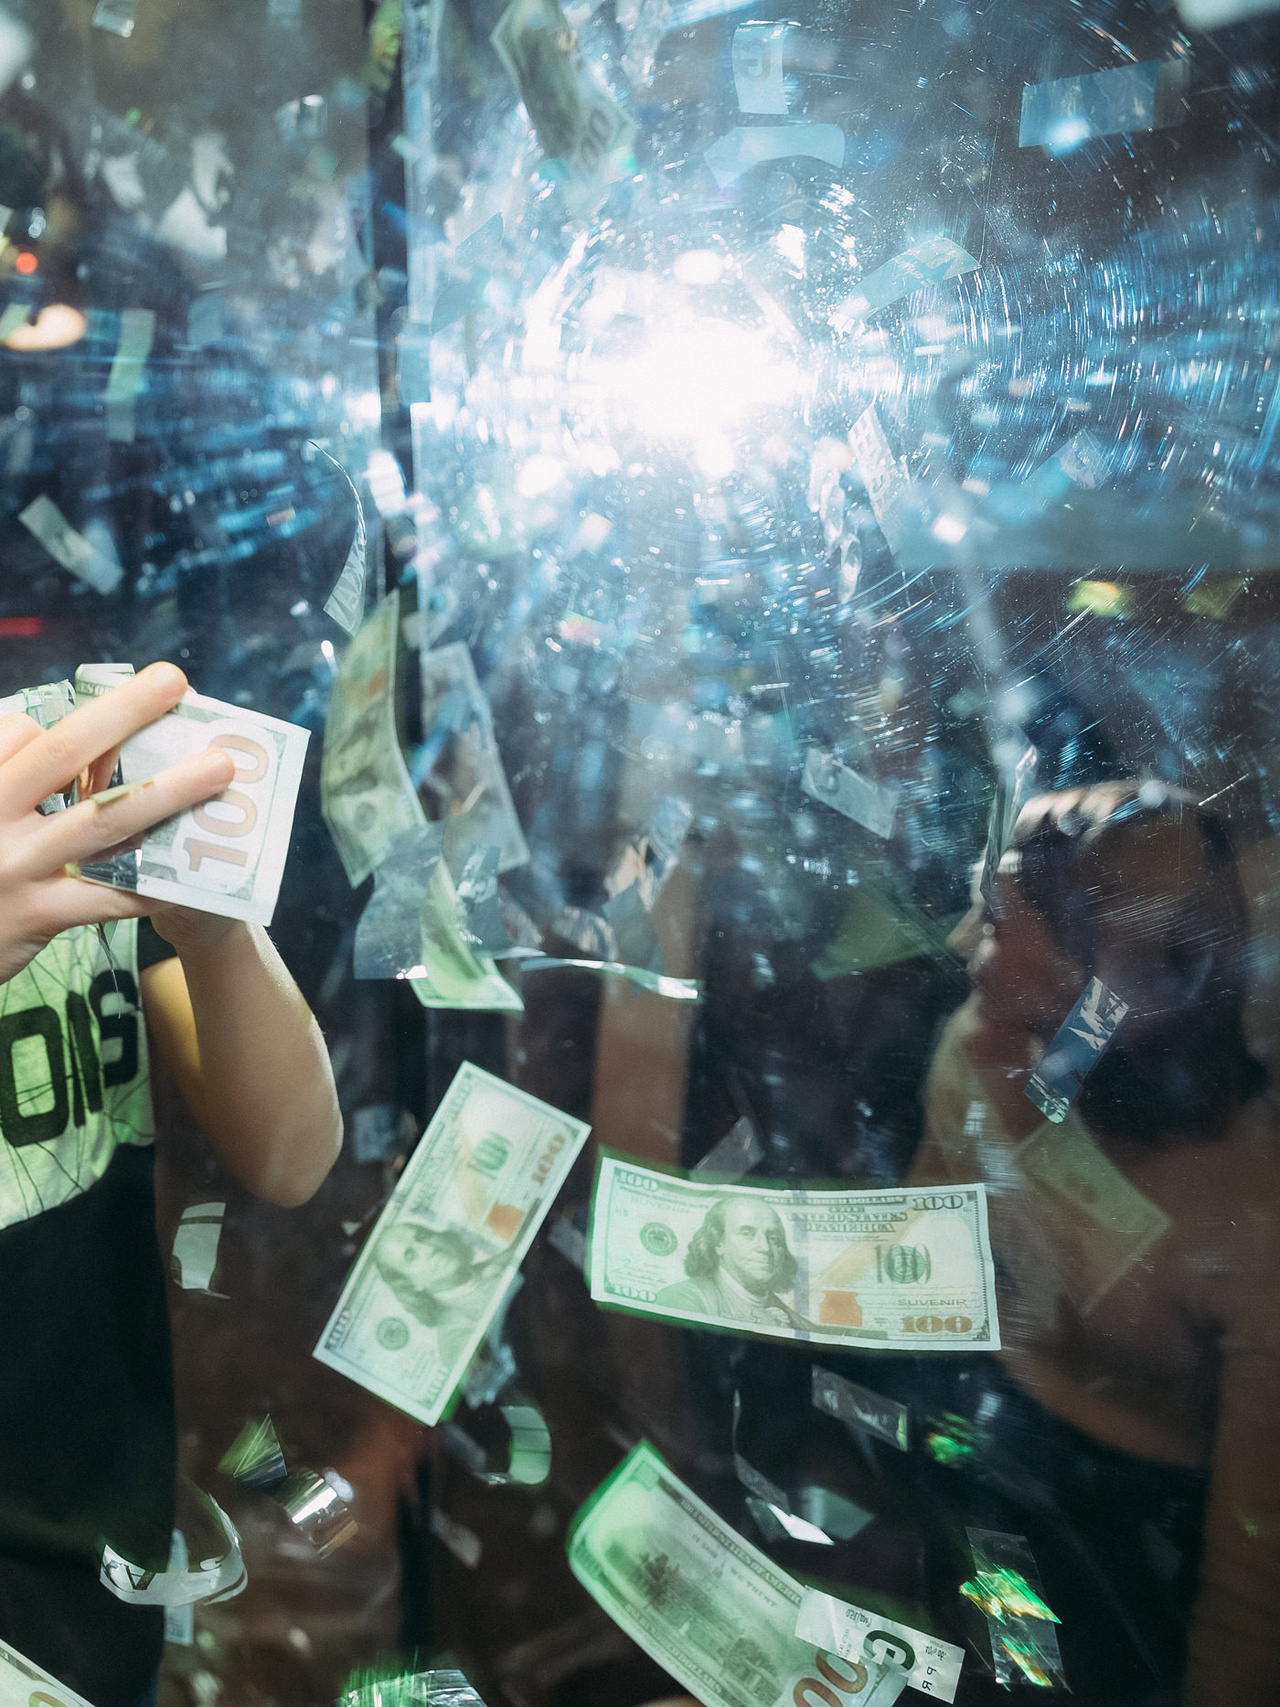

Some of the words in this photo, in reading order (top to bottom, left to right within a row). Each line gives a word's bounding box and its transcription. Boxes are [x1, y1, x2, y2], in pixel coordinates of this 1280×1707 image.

[182, 733, 269, 872] 100
[531, 1134, 566, 1187] 100
[617, 1170, 660, 1193] 100
[913, 1194, 964, 1211] 100
[613, 1284, 658, 1303] 100
[900, 1315, 974, 1333] 100
